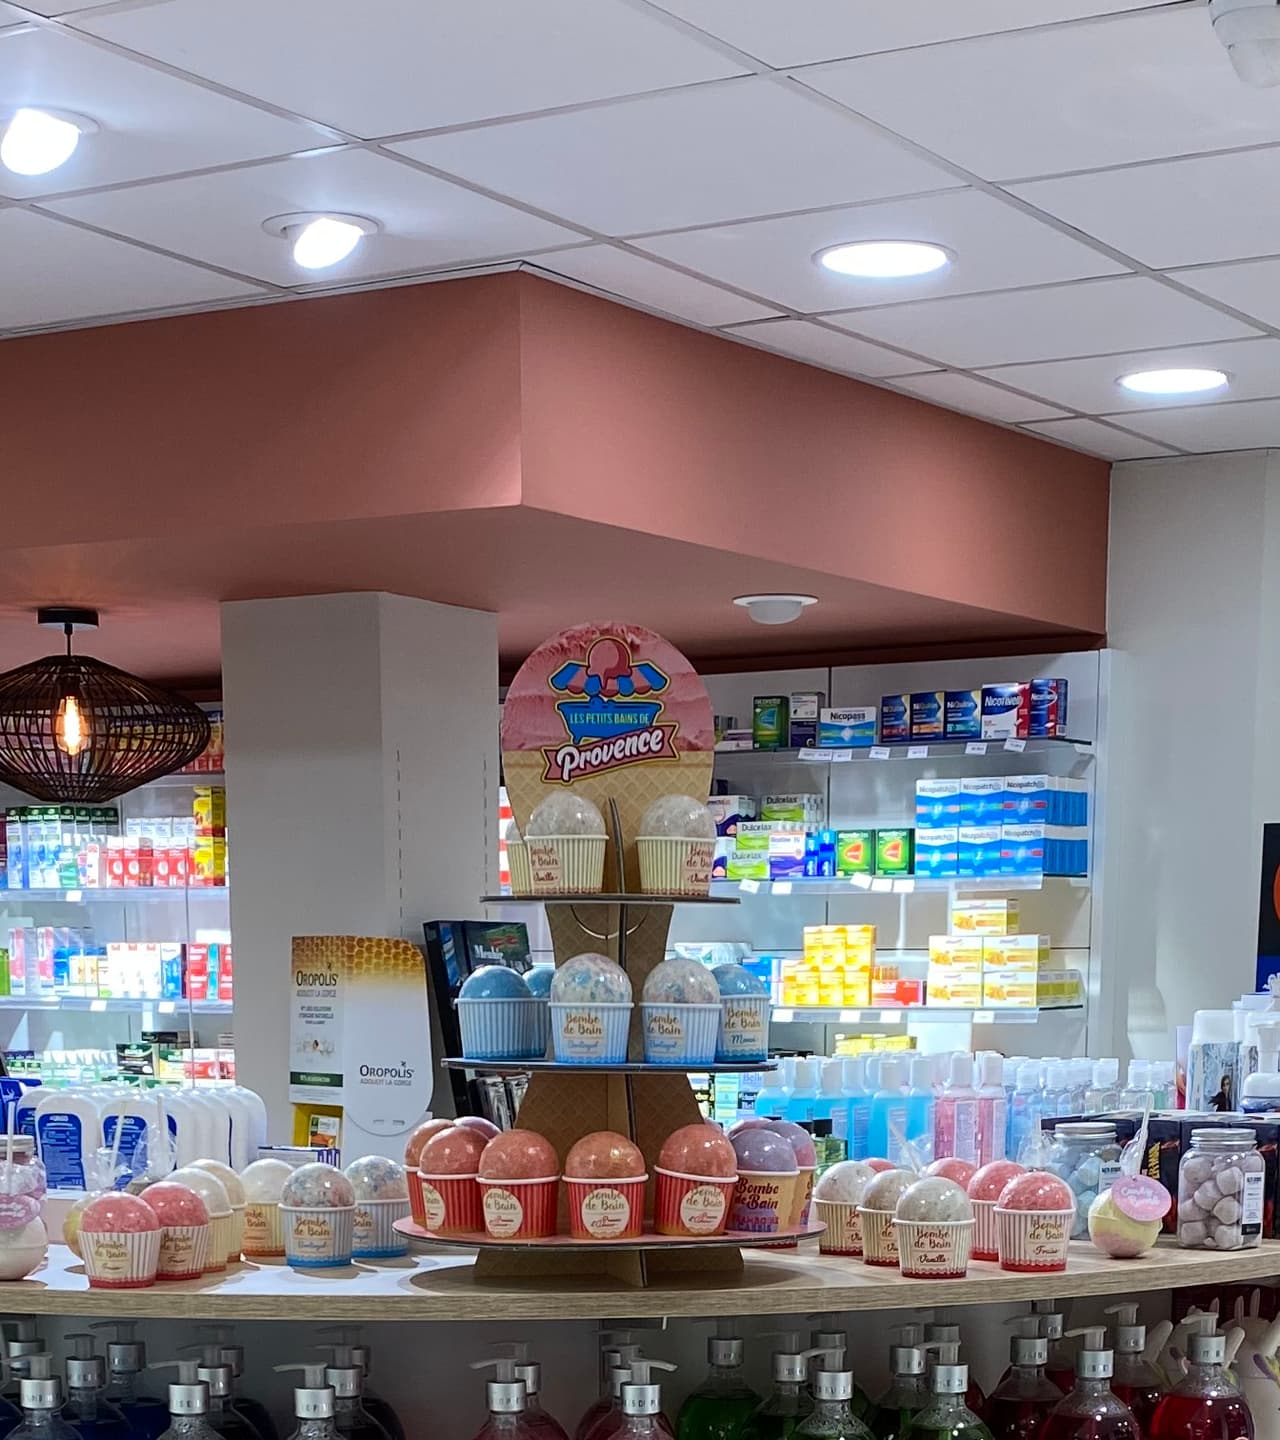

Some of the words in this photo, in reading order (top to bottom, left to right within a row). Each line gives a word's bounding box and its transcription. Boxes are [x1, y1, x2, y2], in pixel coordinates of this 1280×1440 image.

[570, 713, 584, 724] LES
[586, 713, 612, 724] PETITS
[614, 713, 637, 724] BAINS
[556, 728, 664, 782] Provence
